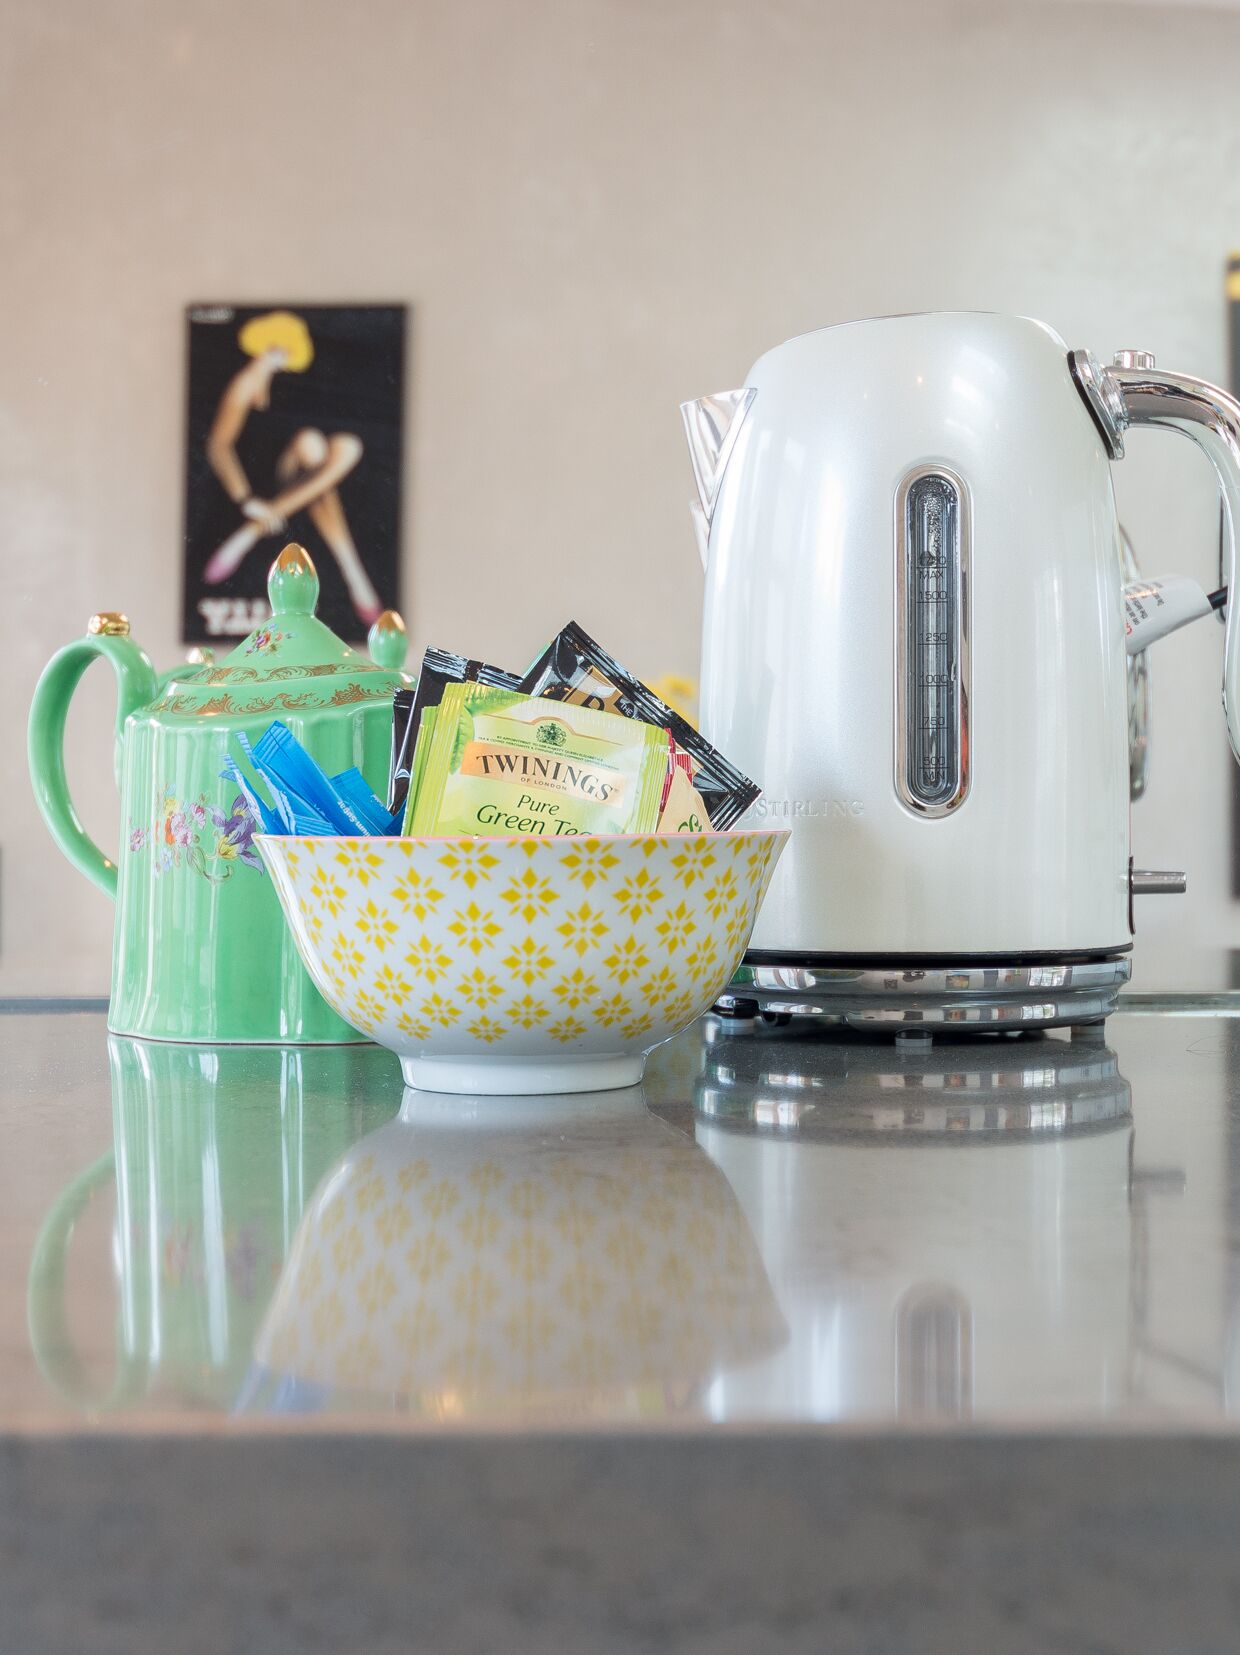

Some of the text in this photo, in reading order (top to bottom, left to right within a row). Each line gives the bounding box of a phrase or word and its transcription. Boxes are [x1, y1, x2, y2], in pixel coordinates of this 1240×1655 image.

[475, 754, 613, 801] TWININGS
[534, 780, 567, 791] LONDON
[517, 794, 560, 816] Pure
[754, 798, 865, 818] STIRLING
[476, 804, 546, 835] Green
